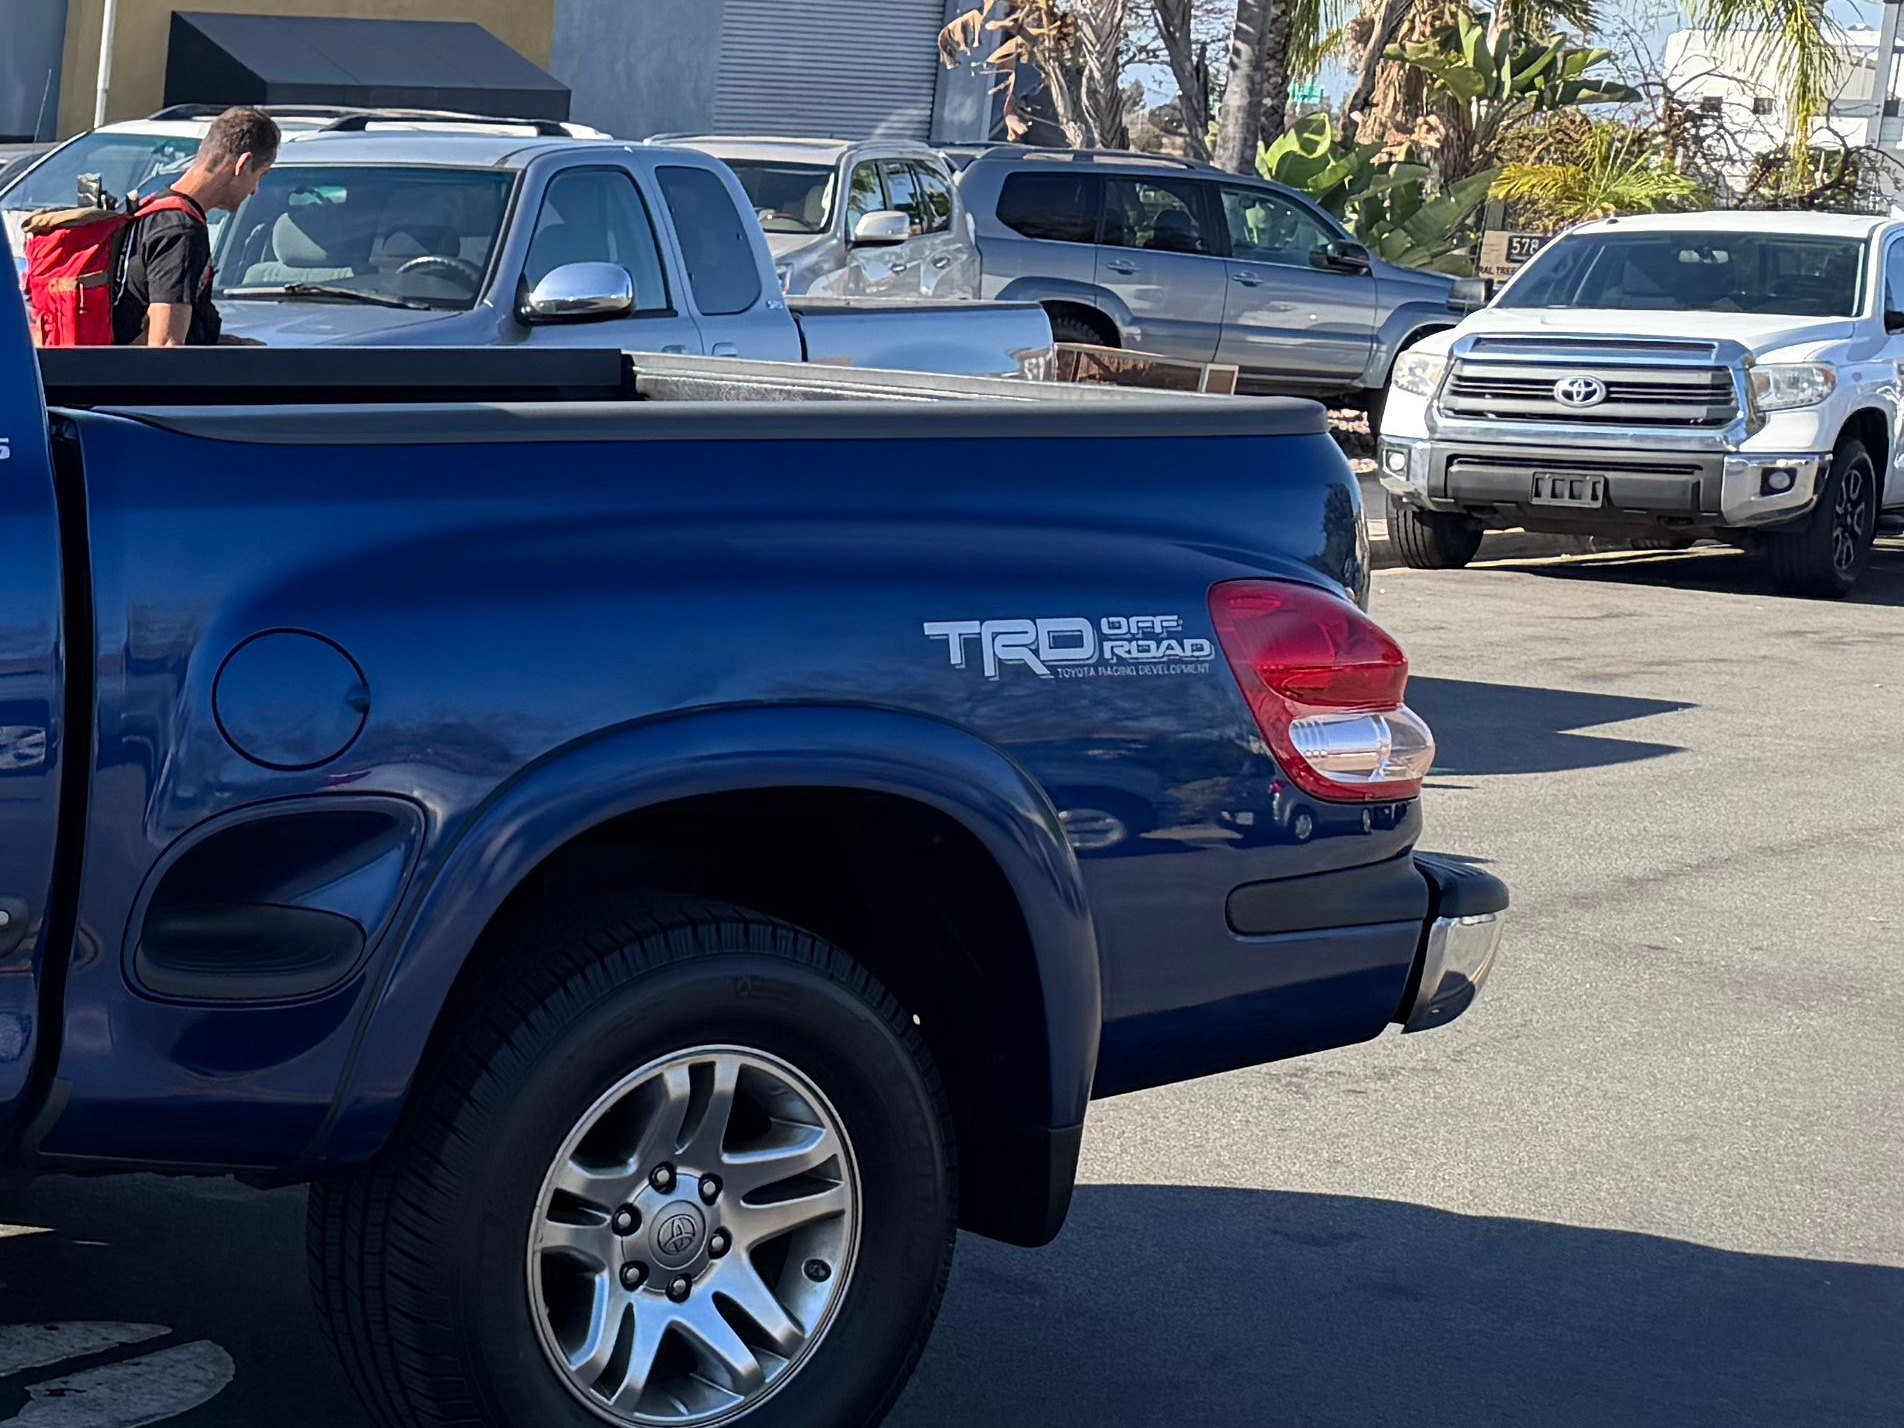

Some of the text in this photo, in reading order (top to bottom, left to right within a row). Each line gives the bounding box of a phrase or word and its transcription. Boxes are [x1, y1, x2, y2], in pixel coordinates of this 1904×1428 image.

[923, 615, 1183, 681] TRD OFF
[1102, 638, 1216, 663] ROAD
[1057, 662, 1210, 679] TOYOTA RACING DEVELOPMENT
